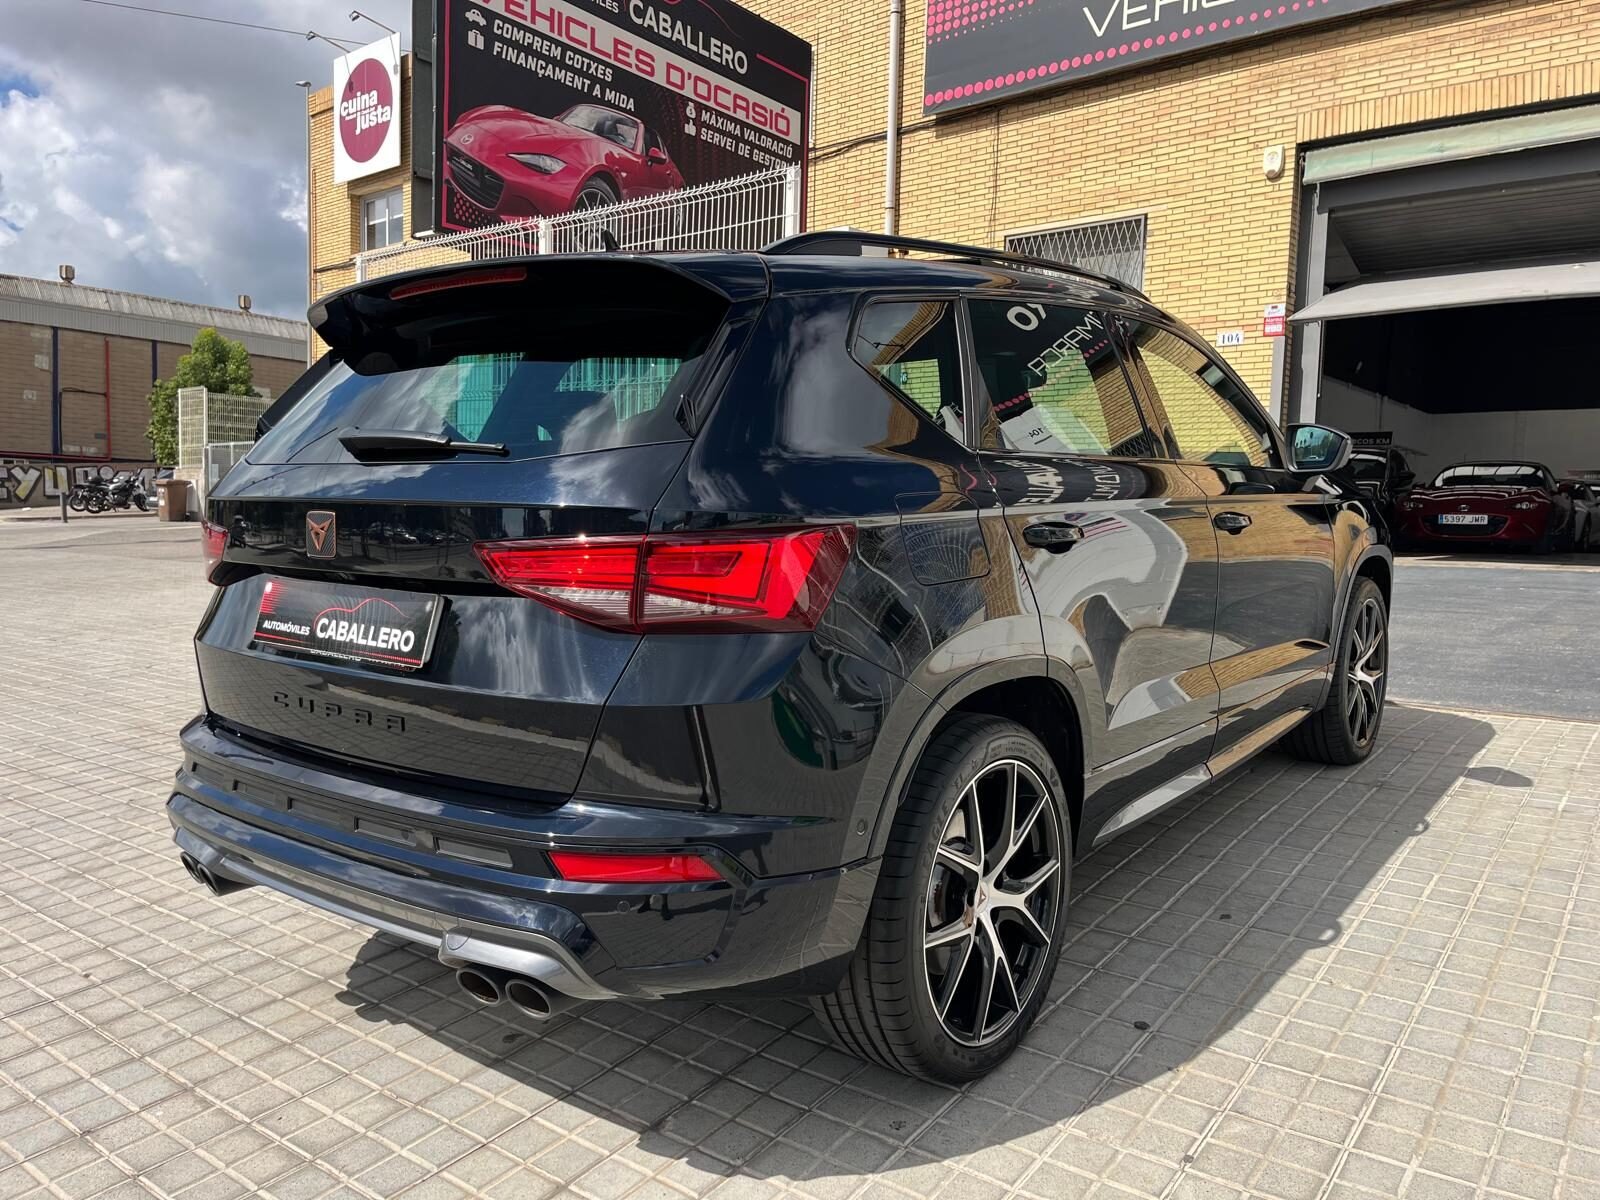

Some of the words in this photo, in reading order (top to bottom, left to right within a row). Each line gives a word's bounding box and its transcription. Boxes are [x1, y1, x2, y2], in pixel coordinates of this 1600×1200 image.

[493, 19, 561, 60] COMPREM
[565, 51, 613, 82] COTXES
[629, 0, 748, 75] CABALLERO
[482, 0, 656, 78] EHICLES
[666, 62, 790, 136] D'OCASIÓ
[493, 41, 591, 92] FINANÇAMENT
[592, 84, 601, 98] A
[605, 88, 635, 112] MIDA
[340, 90, 378, 117] cuina
[355, 104, 391, 136] justa
[700, 128, 736, 153] SERVEI
[738, 142, 750, 158] DE
[701, 108, 741, 137] MÀXIMA
[743, 127, 793, 159] VALORACIÓ
[1222, 333, 1240, 344] 104
[1444, 515, 1466, 523] 5397
[263, 619, 310, 636] AUTOMÓVILES
[316, 618, 415, 653] CABALLERO
